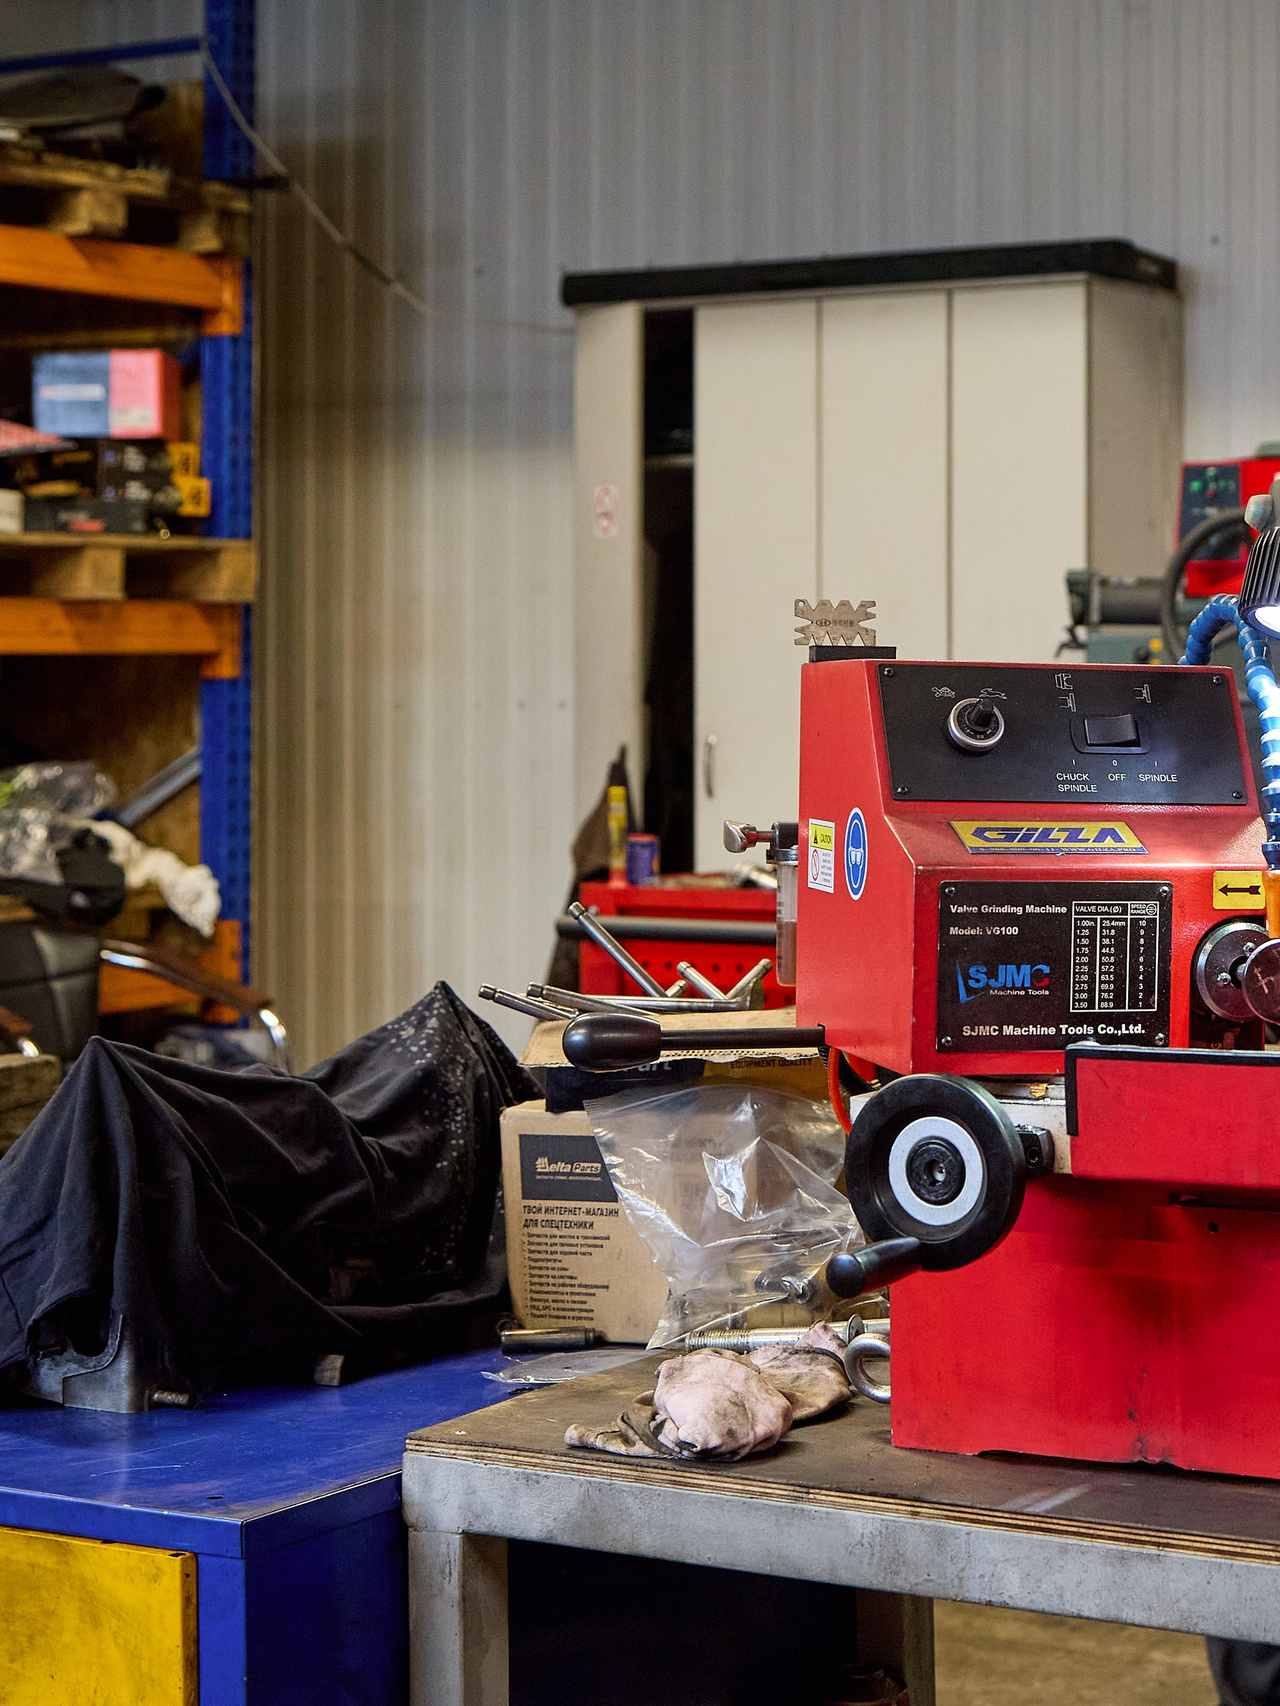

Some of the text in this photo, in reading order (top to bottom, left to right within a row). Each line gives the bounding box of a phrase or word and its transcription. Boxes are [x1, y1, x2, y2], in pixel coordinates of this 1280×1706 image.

[1056, 773, 1090, 781] CHUCK
[1108, 773, 1126, 781] OFF
[1139, 774, 1178, 782] SPINDLE
[1058, 784, 1097, 793] SPINDLE
[950, 904, 1068, 915] Valve Grinding Machine
[949, 926, 1019, 935] Model: VG100
[968, 964, 1050, 988] SJMC
[962, 1023, 1146, 1036] SJMC Machine Tools Co.,Ltd.
[730, 1058, 812, 1069] EQUIPMENT QUALITY
[573, 1163, 600, 1173] Parts
[523, 1204, 619, 1217] ТВОЙ ИНТЕРНЕТ-МАГАЗИН
[522, 1219, 594, 1231] ДЛЯ СПЕЦТЕХНИКИ
